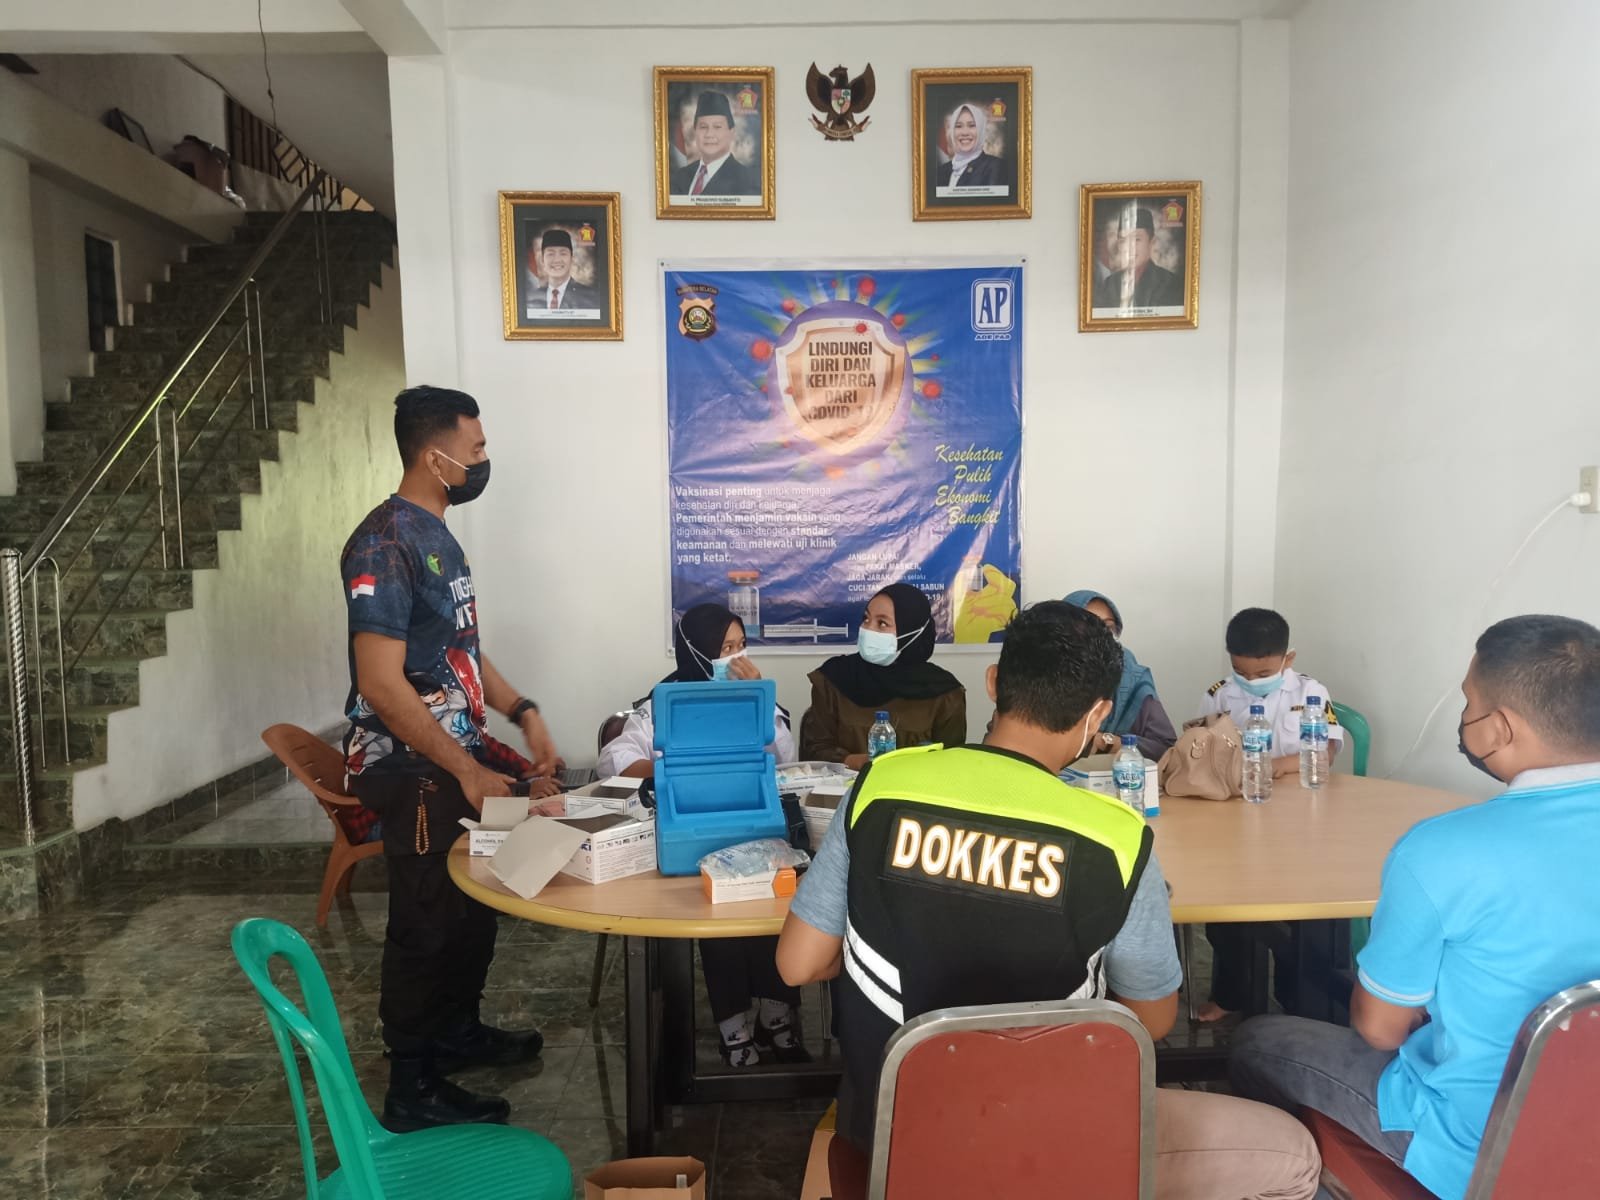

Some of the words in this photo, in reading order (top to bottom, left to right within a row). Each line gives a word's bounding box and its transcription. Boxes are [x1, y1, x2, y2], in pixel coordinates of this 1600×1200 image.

[978, 287, 1008, 324] AP
[808, 341, 872, 356] LINDUNGI
[810, 358, 839, 372] DIRI
[844, 357, 871, 372] DAN
[806, 373, 876, 388] KELUARGA
[825, 389, 858, 404] DARI
[934, 442, 1004, 463] Kesehatan
[954, 463, 992, 485] Pulih
[675, 486, 723, 496] Vaksinasi
[725, 487, 762, 498] penting
[765, 487, 790, 496] untuk
[792, 487, 831, 497] menjaga
[935, 484, 992, 506] Ekonomi
[676, 500, 722, 510] kesehatan
[676, 513, 732, 523] Pemerintah
[734, 513, 782, 524] menjamin
[785, 512, 817, 522] vaksin
[948, 506, 1000, 530] Bangkit
[676, 526, 722, 537] digunakan
[790, 526, 828, 536] standar
[676, 540, 727, 550] keamanan
[729, 540, 746, 549] dan
[748, 538, 793, 549] melewati
[795, 538, 808, 550] uji
[810, 538, 837, 548] klinik
[678, 554, 700, 565] yang
[703, 553, 732, 563] ketat.
[848, 552, 879, 560] JANGAN
[892, 818, 1064, 898] DOKKES
